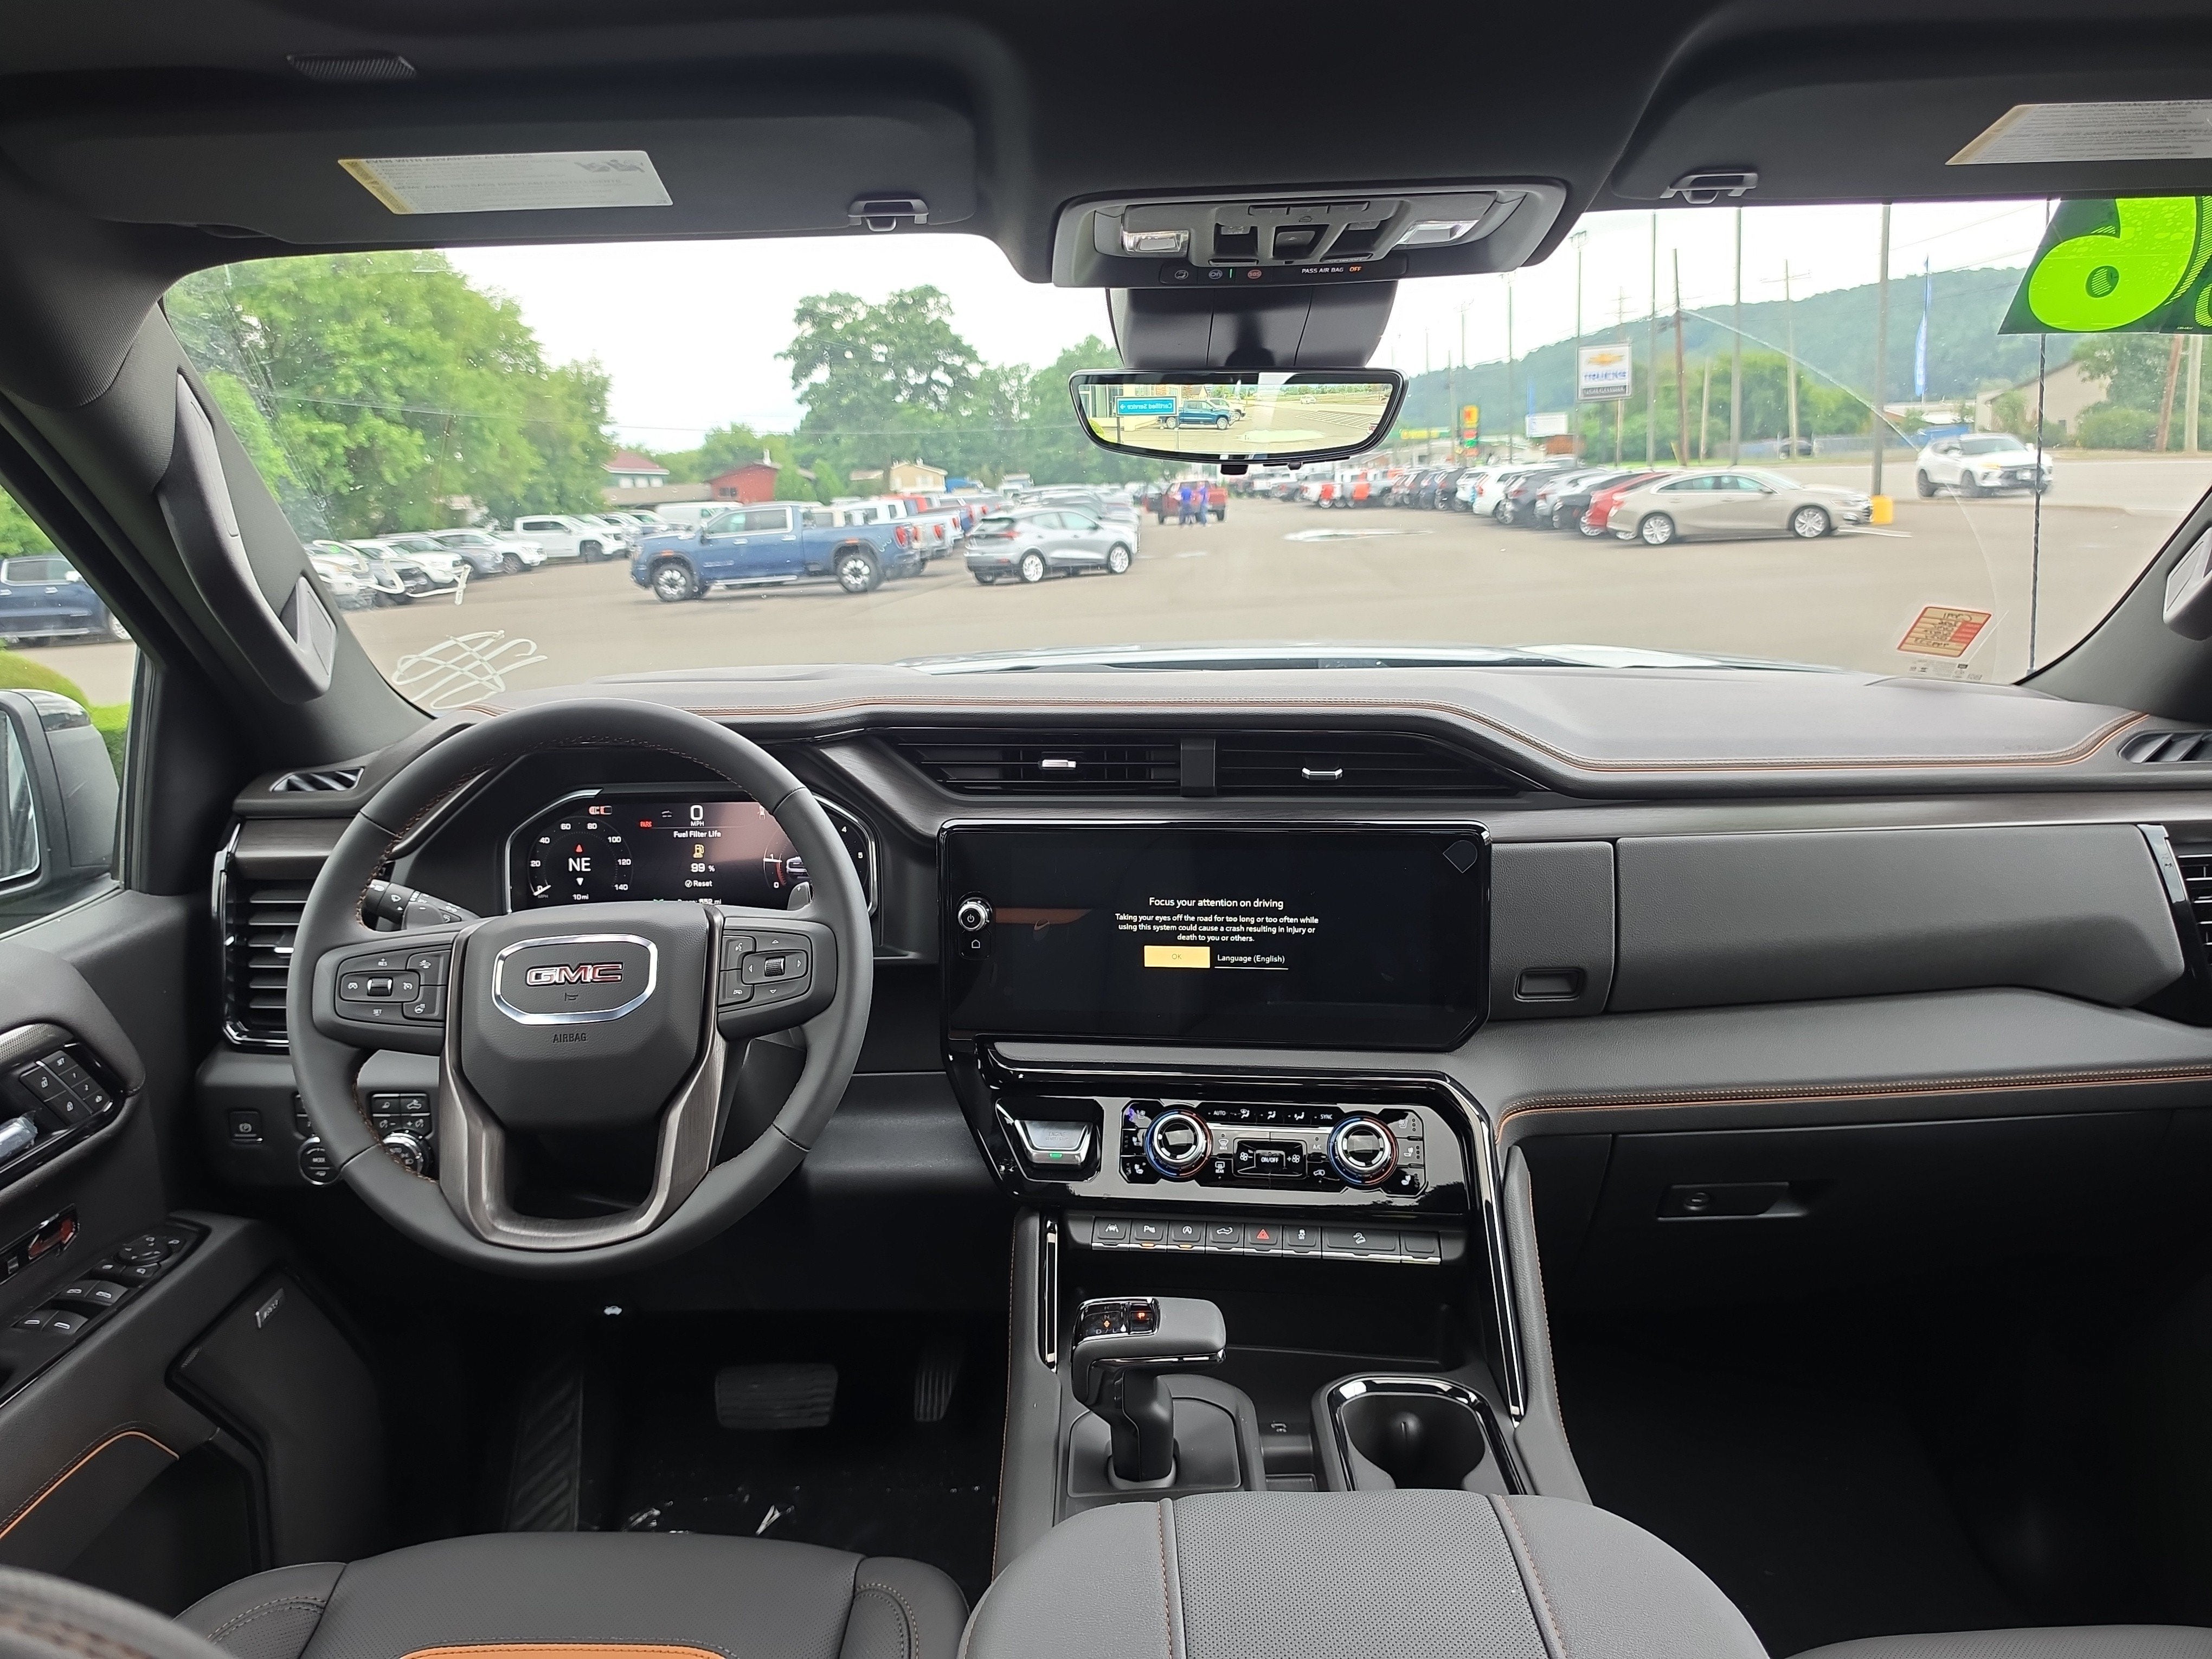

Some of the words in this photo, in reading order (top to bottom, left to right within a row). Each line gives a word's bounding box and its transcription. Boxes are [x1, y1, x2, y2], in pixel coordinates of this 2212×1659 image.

[690, 805, 704, 821] 0
[708, 829, 722, 838] Life
[568, 857, 591, 872] NE
[690, 863, 705, 873] 99
[1149, 897, 1175, 906] Focus
[1176, 899, 1196, 908] your
[1198, 898, 1238, 908] attention
[1253, 899, 1284, 910] driving
[1115, 914, 1137, 922] Taking
[1239, 915, 1255, 924] long
[1118, 924, 1137, 932] using
[1246, 925, 1277, 934] resulting
[1286, 926, 1306, 935] injury
[1217, 954, 1252, 963] Language
[1253, 955, 1285, 963] (English)
[526, 963, 622, 985] GMC
[552, 1032, 587, 1044] AIRBAG
